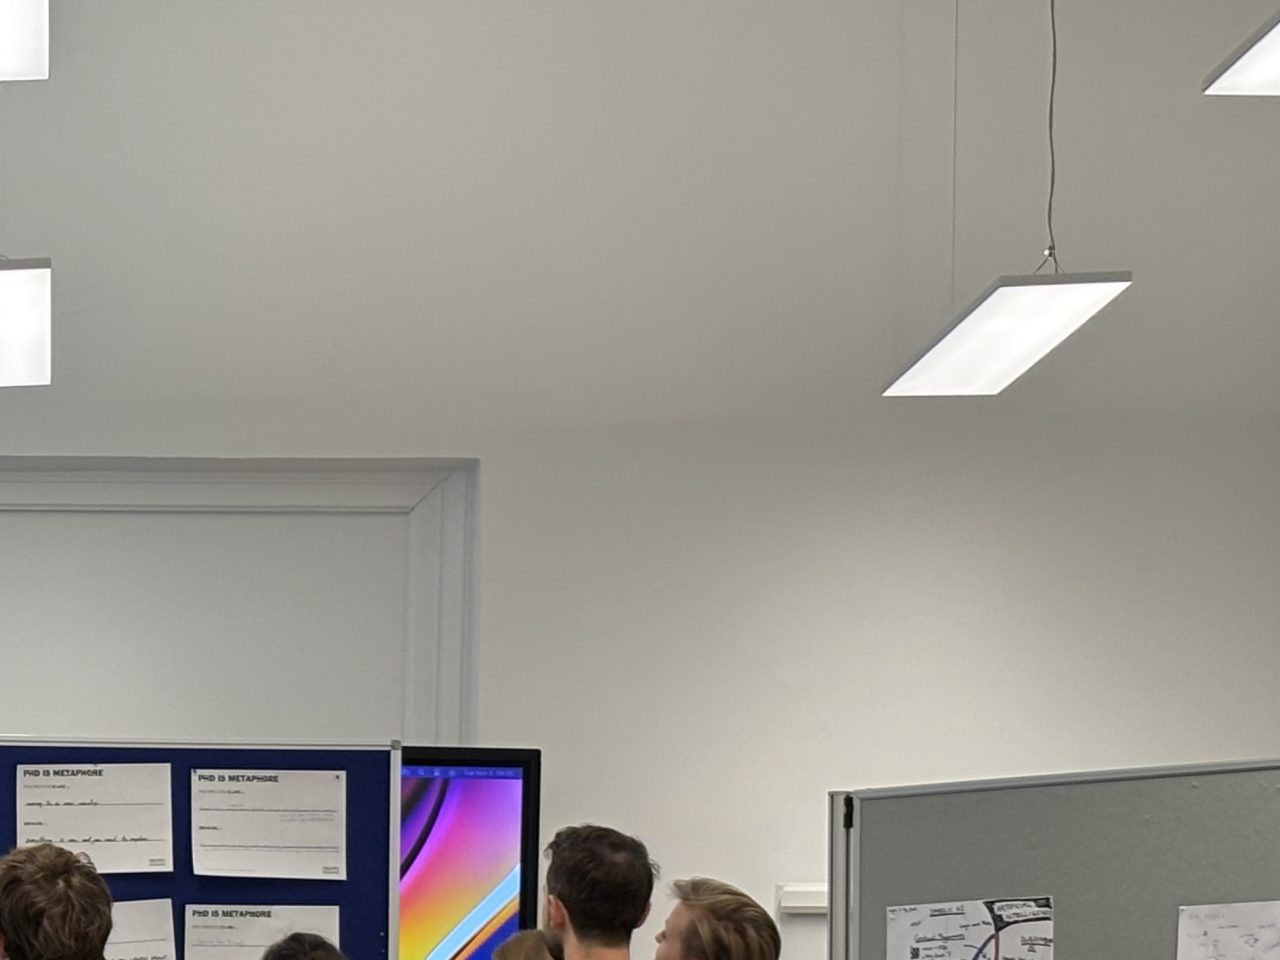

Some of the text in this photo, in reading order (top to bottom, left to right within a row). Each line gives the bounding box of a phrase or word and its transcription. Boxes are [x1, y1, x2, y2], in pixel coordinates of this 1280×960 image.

[23, 769, 104, 777] PHD IS METAPHORE
[198, 774, 215, 782] PHD
[228, 775, 279, 783] METAPHORE
[192, 910, 209, 918] PHD
[222, 910, 272, 918] METAPHORE
